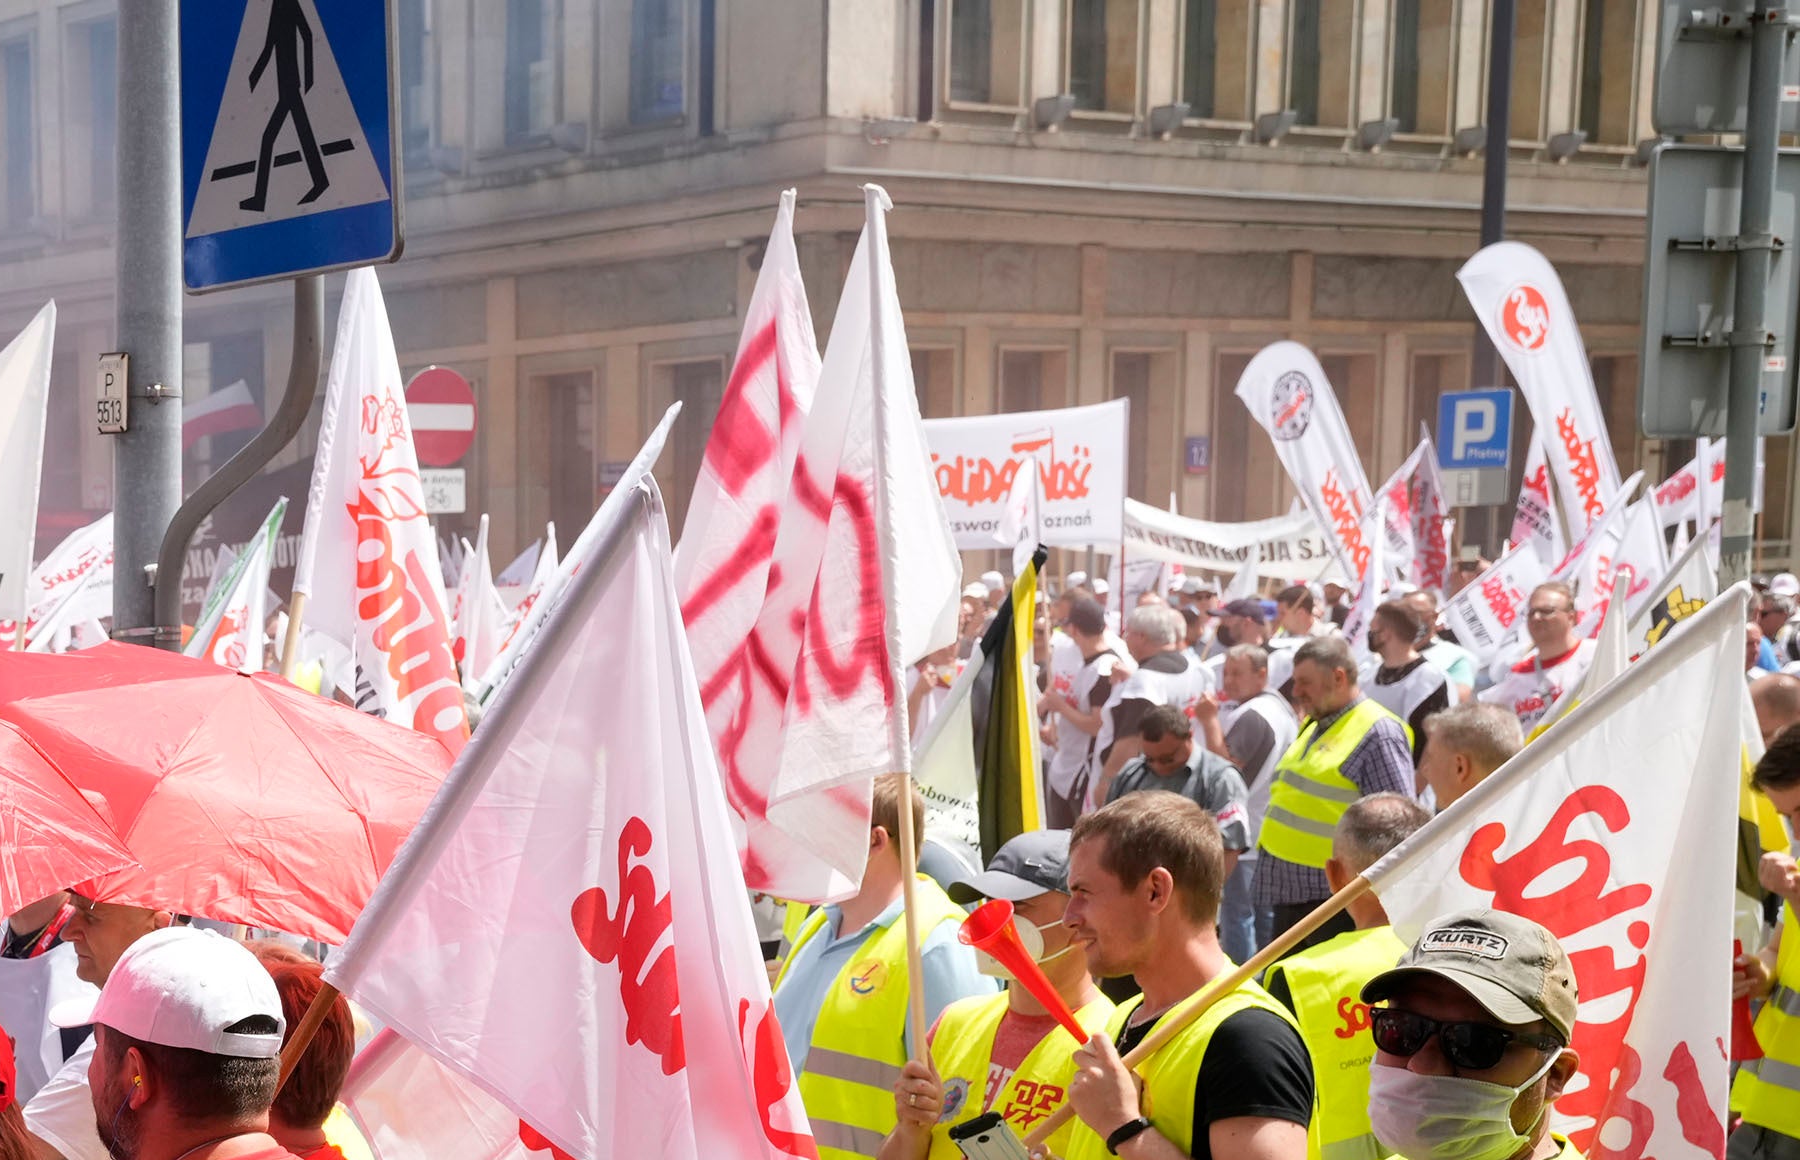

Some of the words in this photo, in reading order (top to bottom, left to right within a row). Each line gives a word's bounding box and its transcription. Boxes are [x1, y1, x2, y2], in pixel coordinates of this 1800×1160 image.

[97, 400, 122, 424] 5513
[1045, 509, 1092, 528] oznań
[1431, 933, 1501, 950] KURTZ
